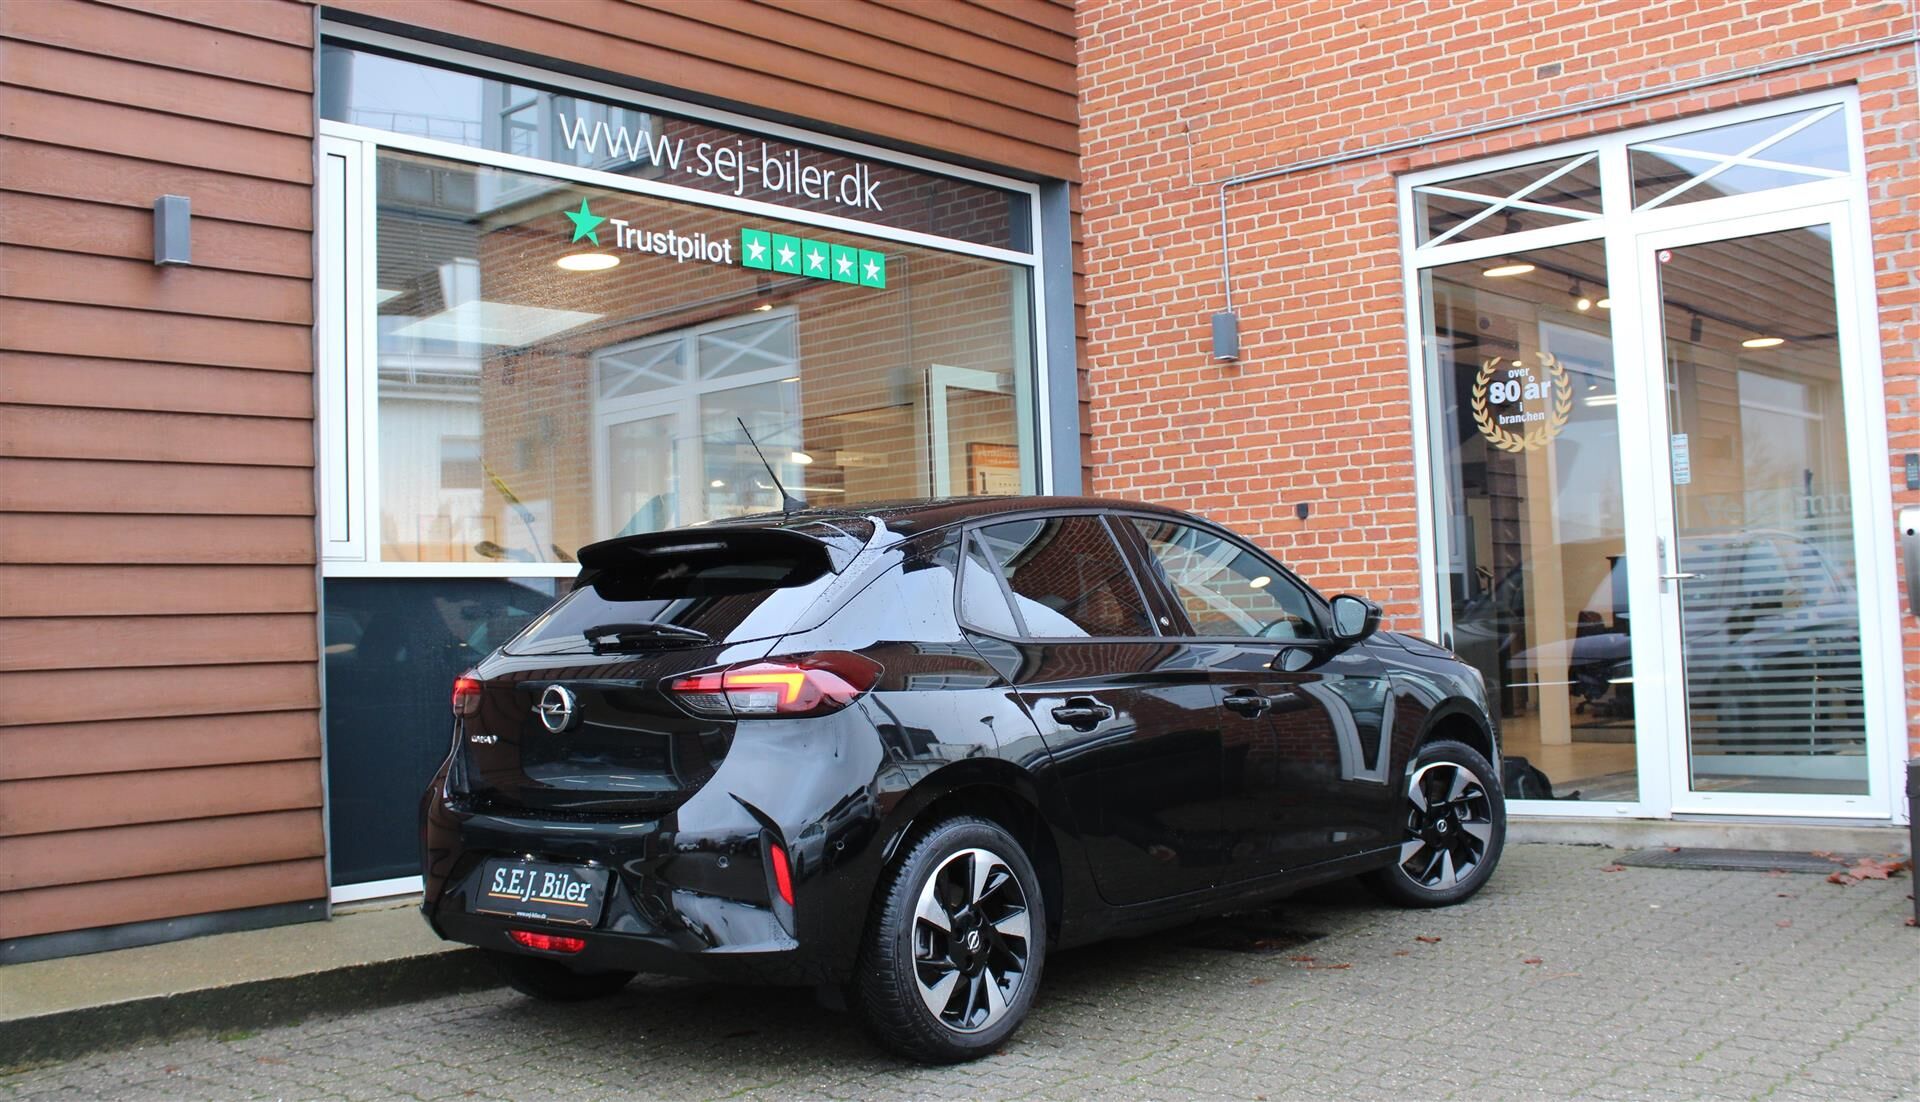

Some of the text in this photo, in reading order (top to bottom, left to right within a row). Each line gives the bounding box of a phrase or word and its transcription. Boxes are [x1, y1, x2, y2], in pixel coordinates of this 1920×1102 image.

[559, 113, 883, 211] www.sej-biler.dk
[610, 218, 733, 264] Trustpilot
[1508, 367, 1530, 379] over
[1489, 375, 1551, 404] 80 år
[1499, 411, 1545, 425] branchen
[1519, 402, 1523, 412] i
[491, 867, 591, 902] S.E.J. Biler
